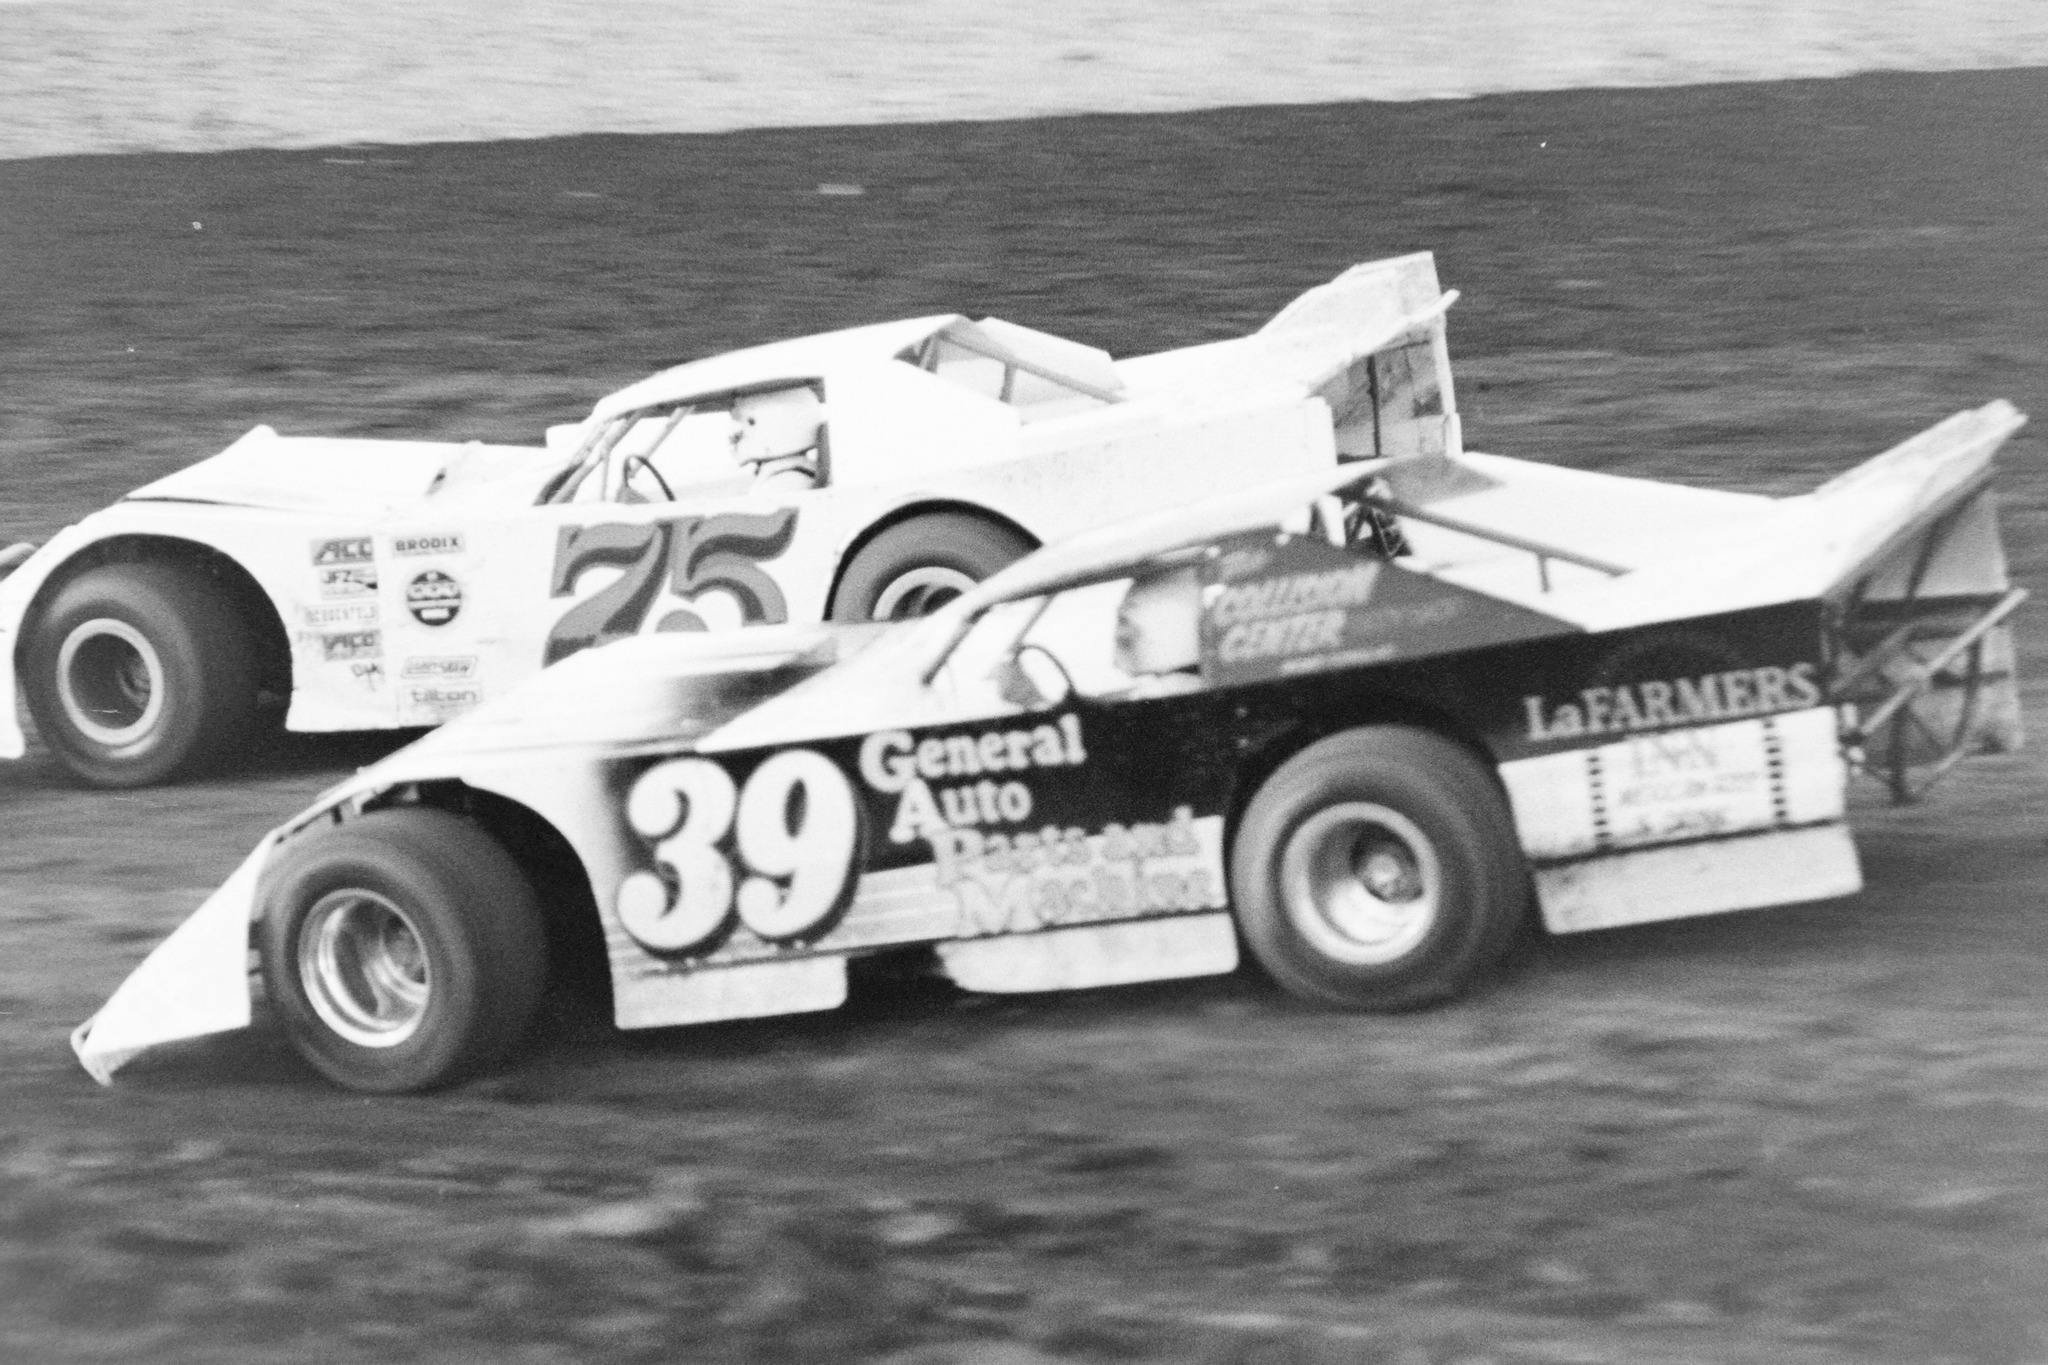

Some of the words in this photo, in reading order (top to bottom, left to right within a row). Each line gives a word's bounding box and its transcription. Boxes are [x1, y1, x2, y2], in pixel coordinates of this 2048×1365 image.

[395, 536, 460, 551] BRODIX
[542, 506, 800, 669] 75
[1523, 661, 1821, 742] LaFARMERS
[858, 712, 1087, 793] General
[616, 749, 858, 951] 39
[887, 777, 1033, 843] Auto
[932, 827, 1092, 888] Parts
